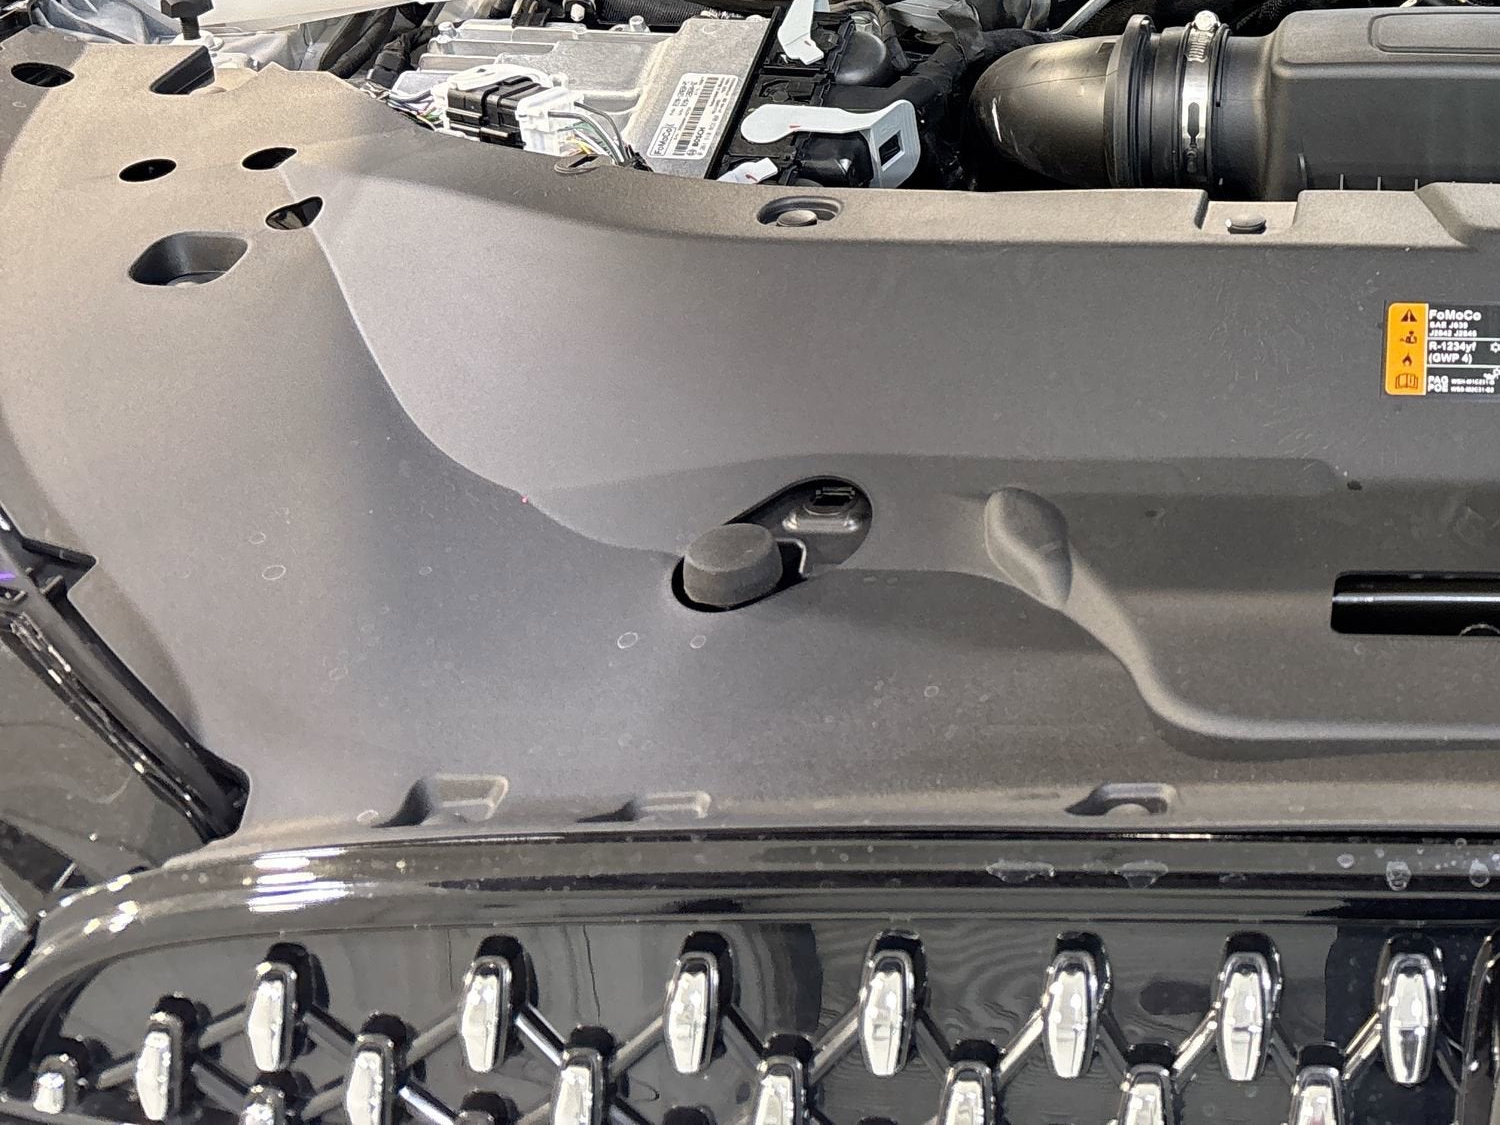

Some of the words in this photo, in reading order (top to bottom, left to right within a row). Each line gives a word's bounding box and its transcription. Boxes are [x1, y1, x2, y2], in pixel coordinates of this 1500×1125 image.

[654, 127, 673, 155] FoMoCo
[691, 127, 706, 147] BOSCH
[1429, 309, 1482, 321] FoMoCo
[1429, 342, 1477, 353] R-1234yf
[1429, 353, 1459, 364] (GWP
[1462, 353, 1472, 364] 4)
[1428, 376, 1448, 384] PAG
[1428, 384, 1448, 392] POE
